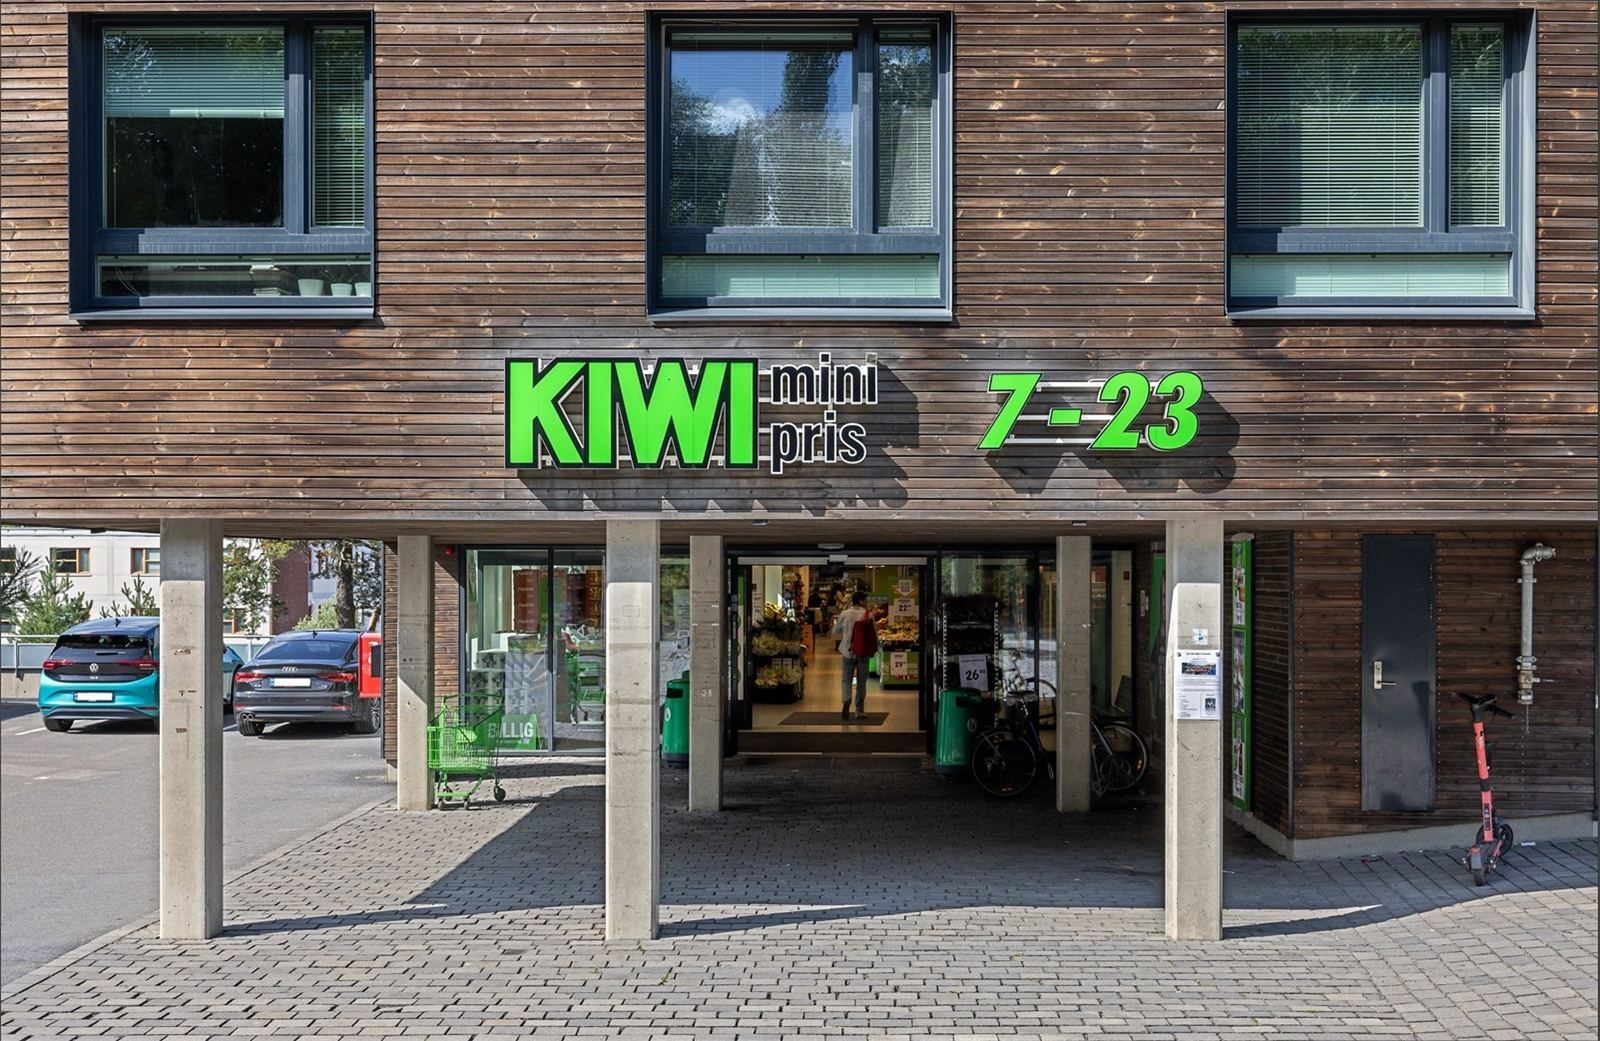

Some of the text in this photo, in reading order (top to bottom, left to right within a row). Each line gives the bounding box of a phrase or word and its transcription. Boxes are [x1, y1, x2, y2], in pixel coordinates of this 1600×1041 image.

[505, 352, 878, 469] KIWI mini
[770, 410, 866, 474] pris
[976, 372, 1043, 450] 7
[1087, 370, 1204, 451] 23
